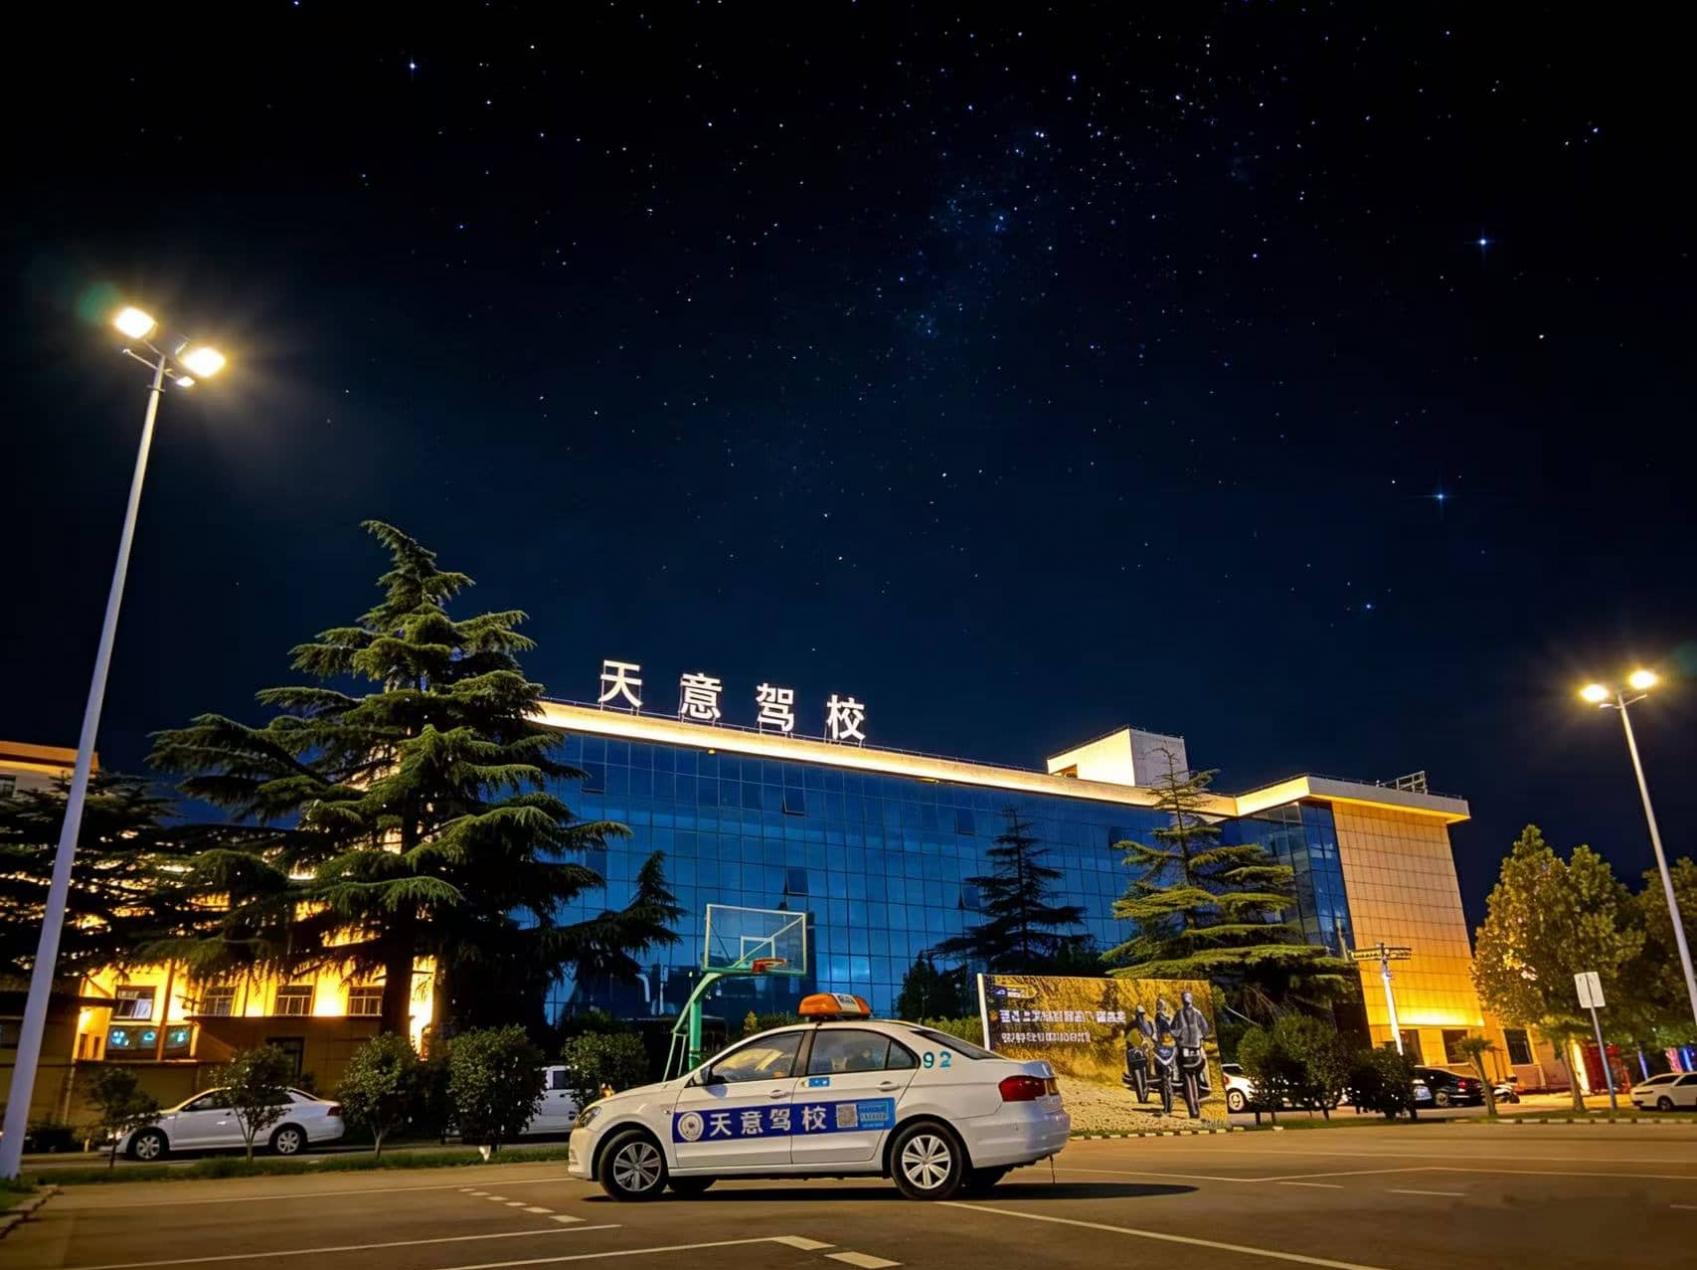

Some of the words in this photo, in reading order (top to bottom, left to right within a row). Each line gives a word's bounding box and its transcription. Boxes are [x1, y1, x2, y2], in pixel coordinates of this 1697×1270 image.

[598, 660, 866, 740] 天意驾校
[923, 1051, 952, 1068] 92
[710, 1105, 827, 1137] 天意驾校
